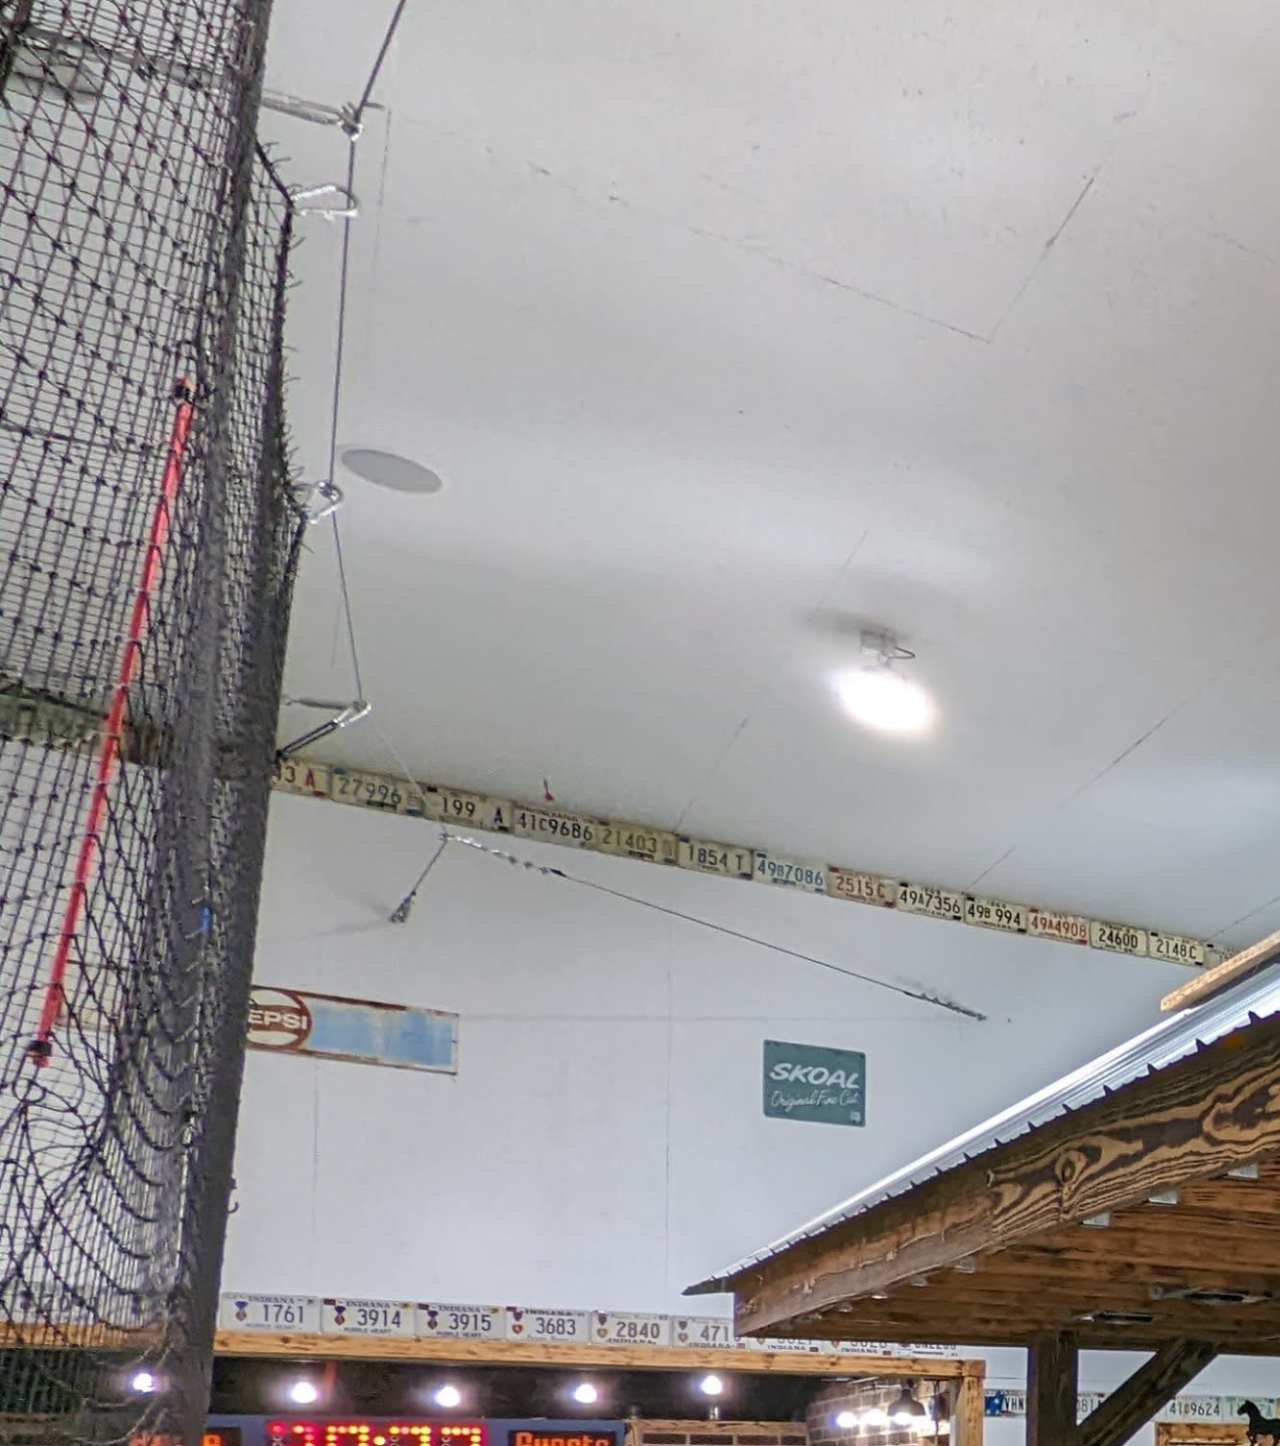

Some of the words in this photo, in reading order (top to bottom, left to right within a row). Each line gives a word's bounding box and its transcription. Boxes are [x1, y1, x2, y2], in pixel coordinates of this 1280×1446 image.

[442, 797, 476, 817] 199
[247, 1009, 308, 1031] EPSI
[769, 1062, 860, 1089] SKOAL
[262, 1304, 305, 1324] 1761
[357, 1308, 401, 1327] 3914
[448, 1313, 492, 1331] 3915
[535, 1317, 576, 1336] 3683
[615, 1321, 660, 1339] 2840
